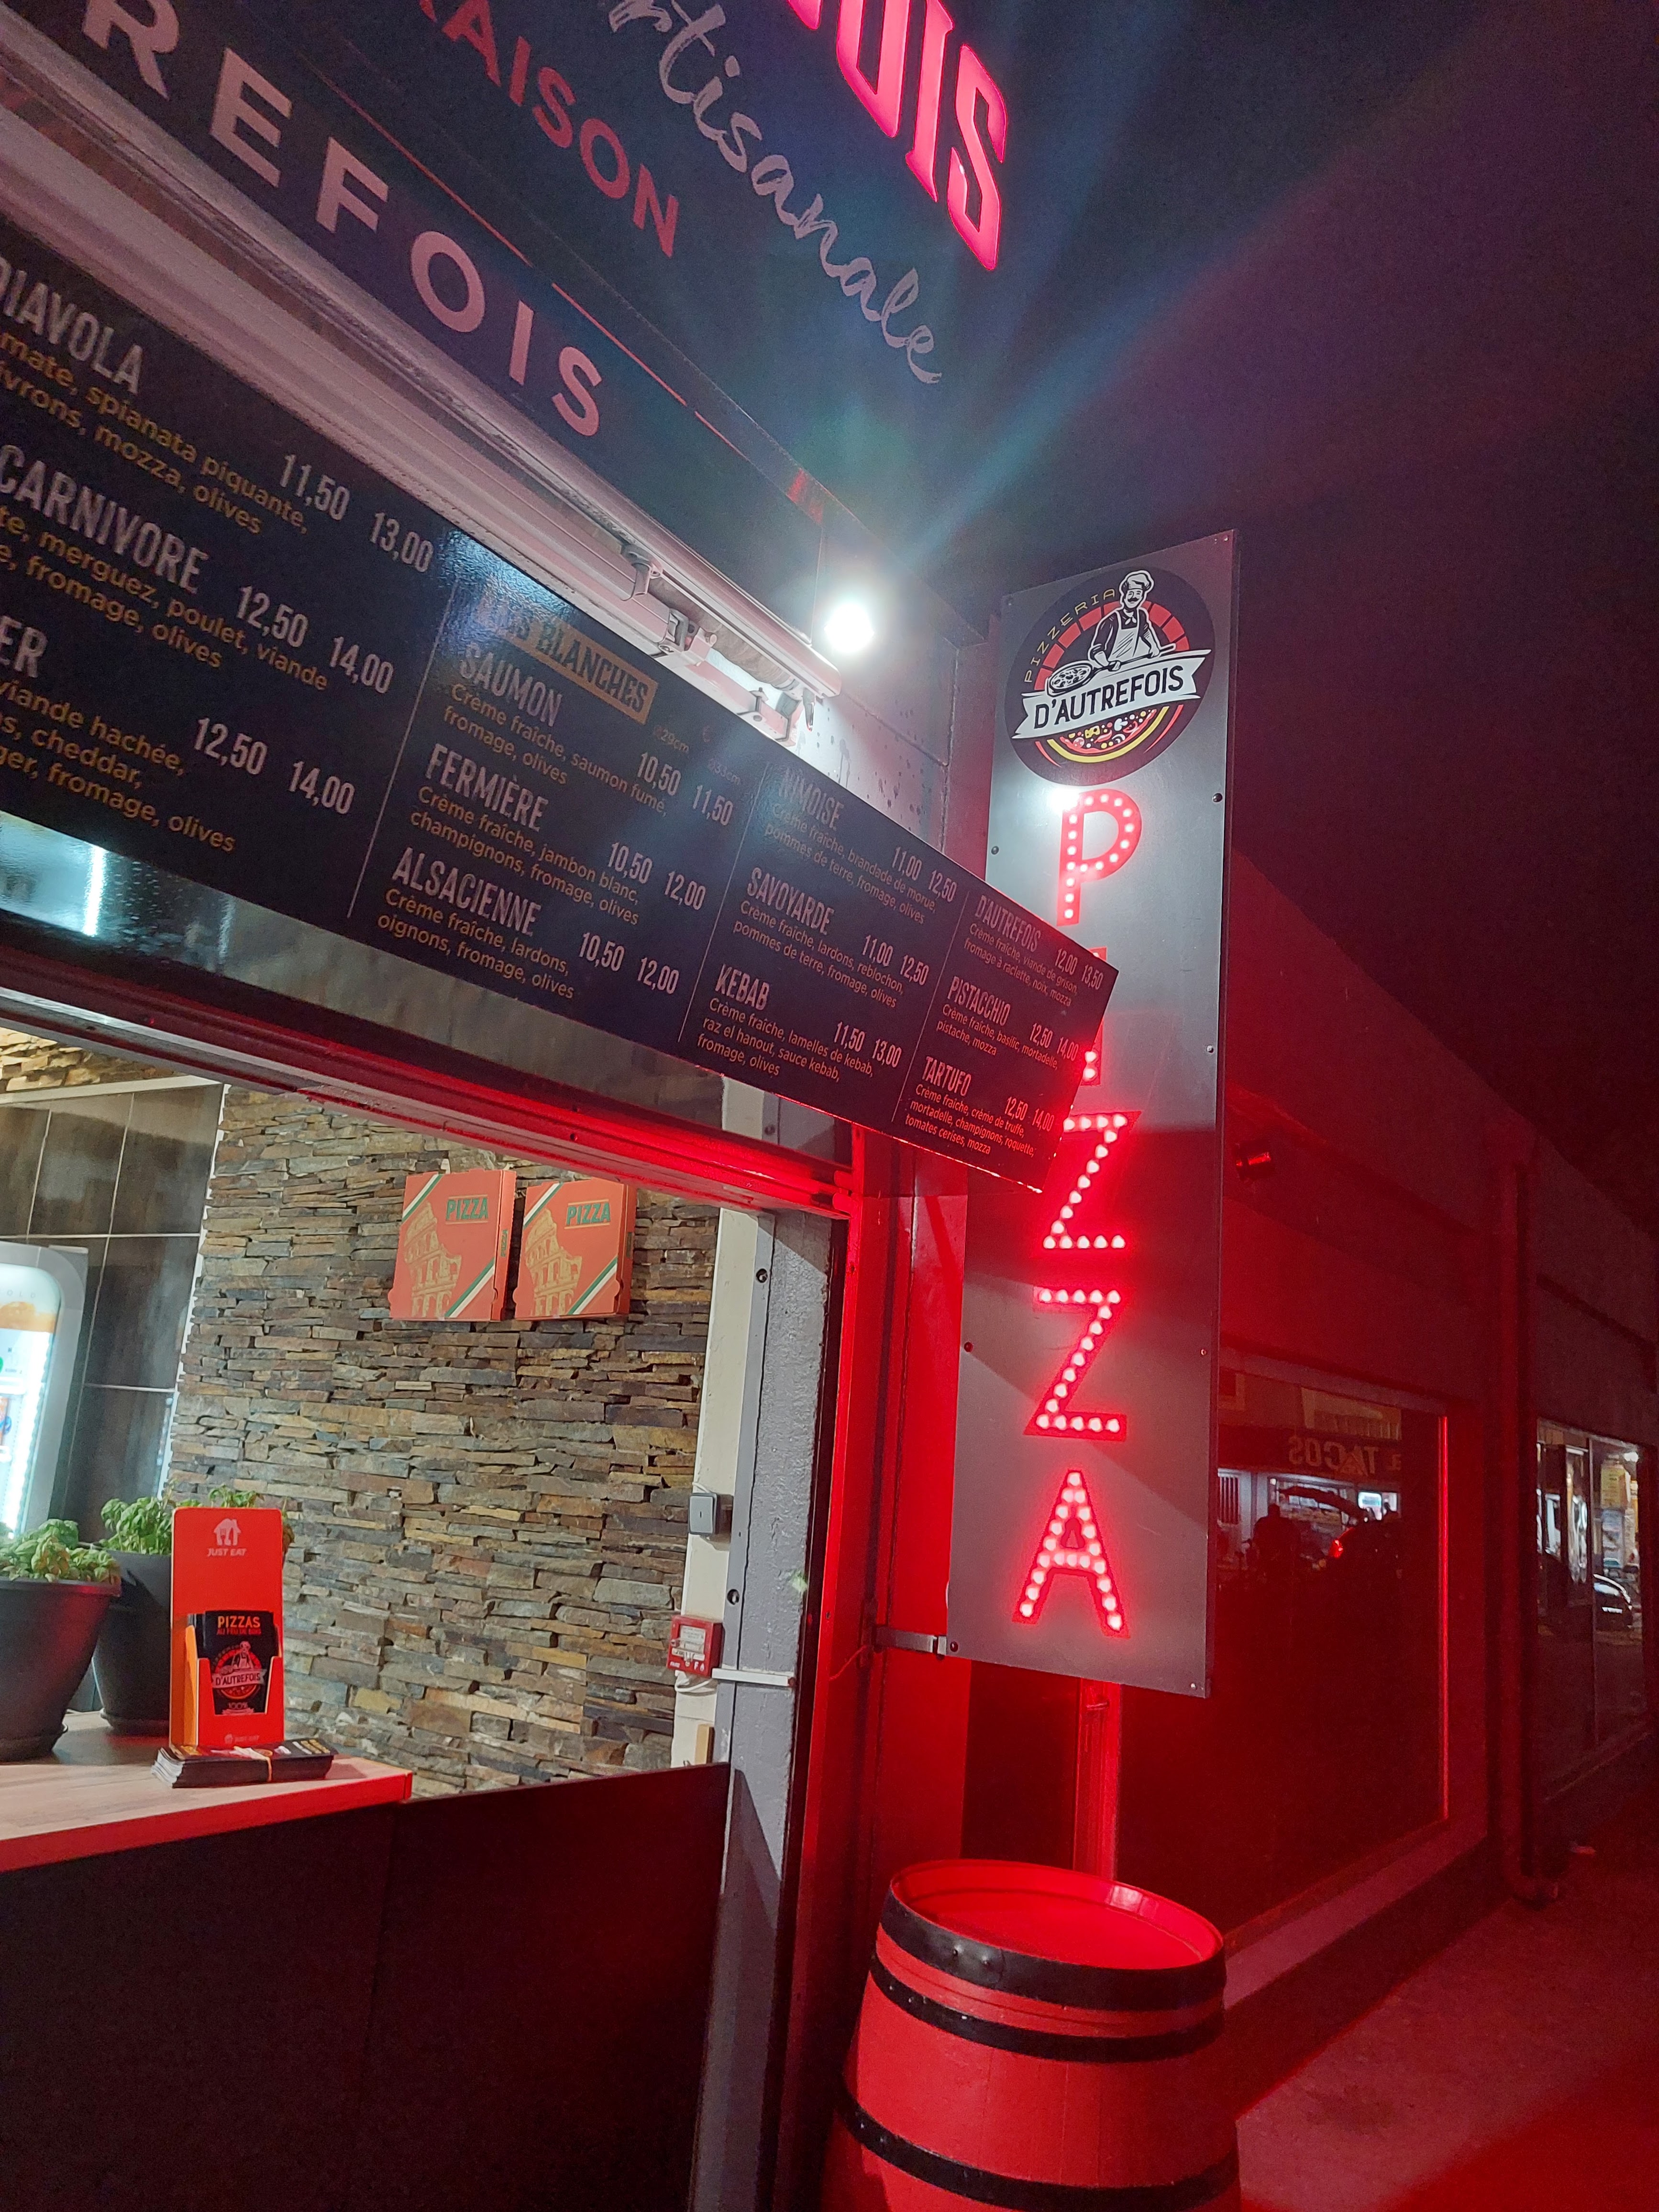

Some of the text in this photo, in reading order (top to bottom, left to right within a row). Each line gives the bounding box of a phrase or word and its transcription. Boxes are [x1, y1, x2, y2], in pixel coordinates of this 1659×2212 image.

[420, 0, 678, 258] AISON
[787, 0, 1007, 270] OIS
[81, 0, 602, 436] REFOIS
[85, 386, 197, 463] spianata
[200, 456, 308, 535] piquante,
[95, 425, 187, 493] mozza,
[193, 485, 263, 534] olives
[0, 444, 209, 594] CARNIVORE
[280, 454, 434, 573] 11,50 13,00
[26, 555, 144, 633] fromage,
[152, 624, 222, 668] olives
[38, 531, 159, 609] merguez,
[166, 598, 248, 655] poulet,
[257, 643, 328, 690] viande
[236, 586, 394, 694] 12,50 14,00
[1024, 588, 1116, 683] PIZZERIA
[459, 643, 563, 727] SAUMON
[1033, 665, 1183, 730] D'AUTREFOIS
[31, 729, 143, 789] cheddar,
[194, 718, 355, 814] 12,50 14,00
[443, 705, 568, 785] fromage, olives
[451, 684, 507, 725] Crème
[570, 753, 628, 793] saumon
[47, 762, 160, 827] fromage,
[167, 815, 236, 852] olives
[426, 743, 549, 832] FERMIÈRE
[637, 752, 733, 825] 10,50 11,50
[410, 809, 639, 925] champignons, fromage, olives
[418, 785, 639, 905] Crème fraîche, jambon blanc,
[608, 842, 706, 910] 10,50 12,00
[765, 822, 925, 925] pommes de terre, fromage, olives
[891, 846, 957, 902] 11,00 12,50
[391, 847, 542, 936] ALSACIENNE
[747, 867, 835, 935] SAVOYARDE
[848, 849, 893, 885] brandade
[894, 877, 906, 893] de
[907, 887, 936, 913] morue,
[377, 914, 574, 999] oignons, fromage, olives
[385, 888, 569, 976] Crème fraîche, lardons,
[741, 900, 776, 929] Crème
[817, 939, 854, 970] lardons,
[857, 962, 904, 995] reblochon,
[969, 923, 995, 943] Crème
[1023, 956, 1046, 976] viande
[1047, 969, 1056, 981] de
[974, 895, 1041, 952] D'AUTREFOIS
[579, 932, 679, 994] 10,50 12,00
[715, 964, 770, 1010] KEBAB
[733, 920, 897, 1008] pommes de terre, fromage, olives
[862, 934, 929, 985] 11,00 12,50
[964, 937, 995, 964] fromage
[1003, 962, 1031, 986] raclette,
[1032, 979, 1048, 996] noix,
[1050, 988, 1072, 1007] mozza
[1055, 948, 1104, 990] 12,00 13,50
[947, 976, 1011, 1026] PISTACCHIO
[697, 1033, 781, 1076] fromage, olives
[703, 1017, 840, 1082] raz el hanout, sauce kebab,
[709, 997, 746, 1023] Crème
[788, 1029, 830, 1057] lamelles
[830, 1049, 843, 1062] de
[844, 1053, 874, 1078] kebab,
[834, 1021, 902, 1068] 11,50 13,00
[936, 1020, 997, 1056] pistache, mozza
[942, 1004, 968, 1025] Crème
[997, 1030, 1020, 1051] basilic,
[1021, 1045, 1058, 1070] mortadelle,
[1029, 1023, 1079, 1062] 12,50 14,00
[922, 1056, 972, 1096] TARTUFO
[905, 1114, 991, 1155] tomates cerises, mozza
[910, 1100, 953, 1126] mortadelle,
[956, 1117, 1004, 1145] champignons,
[916, 1084, 942, 1104] Crème
[971, 1107, 994, 1124] crème
[995, 1116, 1004, 1128] de
[1005, 1119, 1024, 1139] truffe,
[1005, 1096, 1055, 1132] 12,50 14,00
[446, 1197, 488, 1220] PIZZA
[566, 1203, 610, 1225] PIZZA
[1012, 787, 1142, 1639] PZZA
[207, 1548, 247, 1557] JUST EAT
[218, 1616, 260, 1628] PIZZAS
[216, 1673, 261, 1686] D'AUTREFOIS
